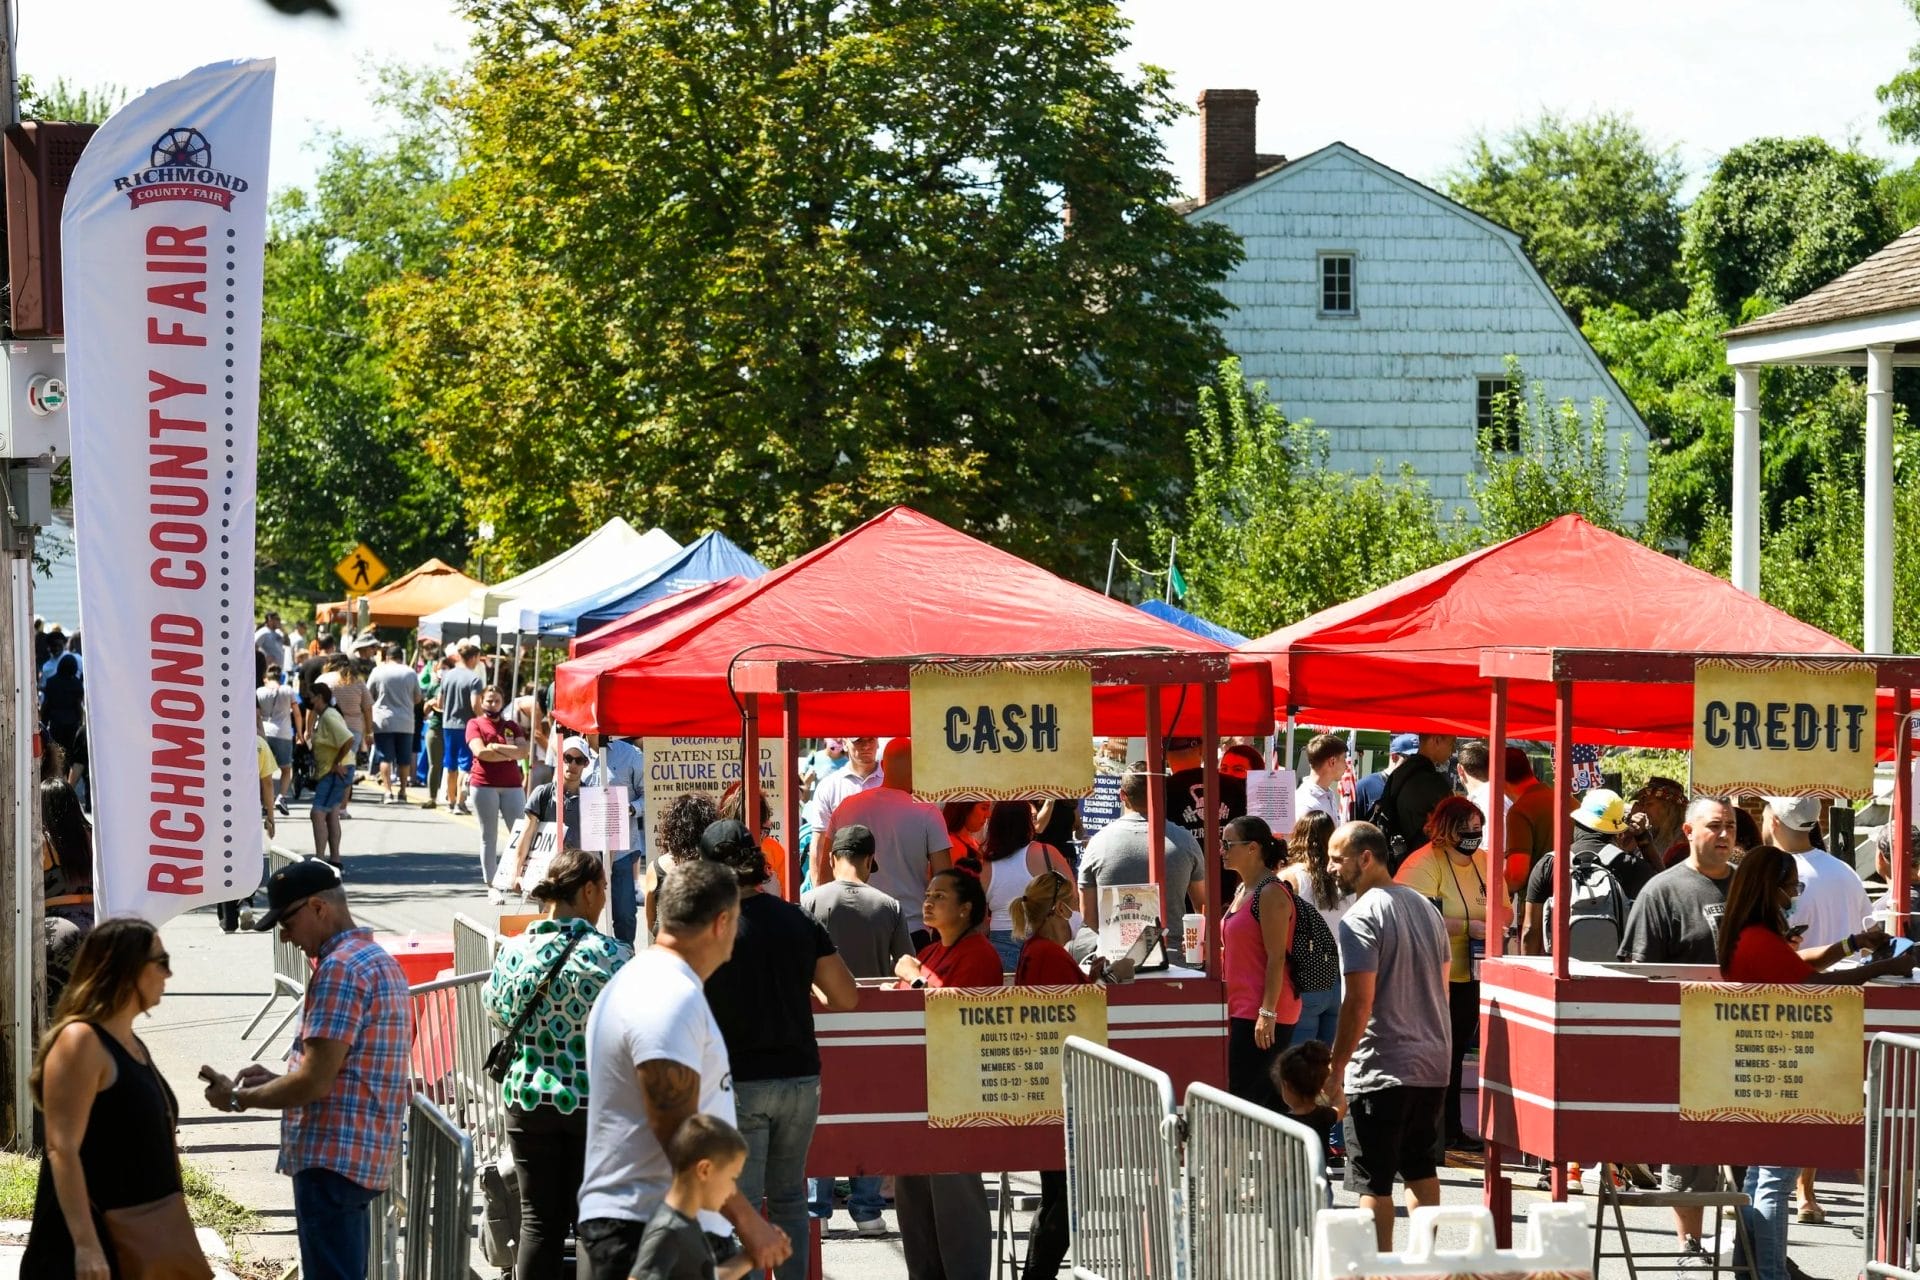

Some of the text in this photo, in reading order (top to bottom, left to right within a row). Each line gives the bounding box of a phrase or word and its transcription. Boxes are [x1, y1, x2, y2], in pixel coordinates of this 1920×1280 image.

[114, 168, 248, 192] RICHMOND
[146, 225, 209, 896] RICHMOND COUNTY FAIR
[943, 703, 1060, 754] CASH
[1703, 700, 1868, 752] CREDIT
[653, 748, 772, 763] STATEN ISLD
[651, 761, 777, 781] CULTURE CRWL
[676, 781, 719, 792] RICHMOND
[758, 780, 775, 790] AIR
[959, 1004, 1077, 1026] TICKET PRICES
[1714, 1003, 1833, 1022] TICKET PRICES
[981, 1033, 1008, 1042] ADULTS
[1010, 1032, 1028, 1042] (12+)
[1036, 1031, 1059, 1041] $10.00
[1735, 1030, 1763, 1038] ADULTS
[1765, 1030, 1783, 1039] (12+)
[1791, 1030, 1815, 1039] $10.00
[981, 1048, 1010, 1057] SENIORS
[1013, 1047, 1031, 1056] (65+)
[1040, 1046, 1059, 1055] $8.00
[1735, 1044, 1765, 1053] SENIORS
[1767, 1045, 1786, 1054] (65+)
[1794, 1045, 1815, 1054] $8.00
[981, 1063, 1016, 1072] MEMBERS
[1024, 1062, 1044, 1071] $8.00
[1735, 1059, 1770, 1068] MEMBERS
[1778, 1060, 1798, 1069] $8.00
[981, 1078, 998, 1087] KIDS
[1000, 1077, 1022, 1087] (3-12)
[1030, 1076, 1049, 1086] $5.00
[1735, 1074, 1751, 1083] KIDS
[1753, 1074, 1775, 1083] (3-12)
[1783, 1075, 1804, 1084] $5.00
[982, 1093, 999, 1102] KIDS
[1000, 1092, 1019, 1102] (0-3)
[1027, 1092, 1045, 1100] FREE
[1734, 1089, 1751, 1098] KIDS
[1753, 1089, 1772, 1098] (0-3)
[1780, 1090, 1800, 1099] FREE
